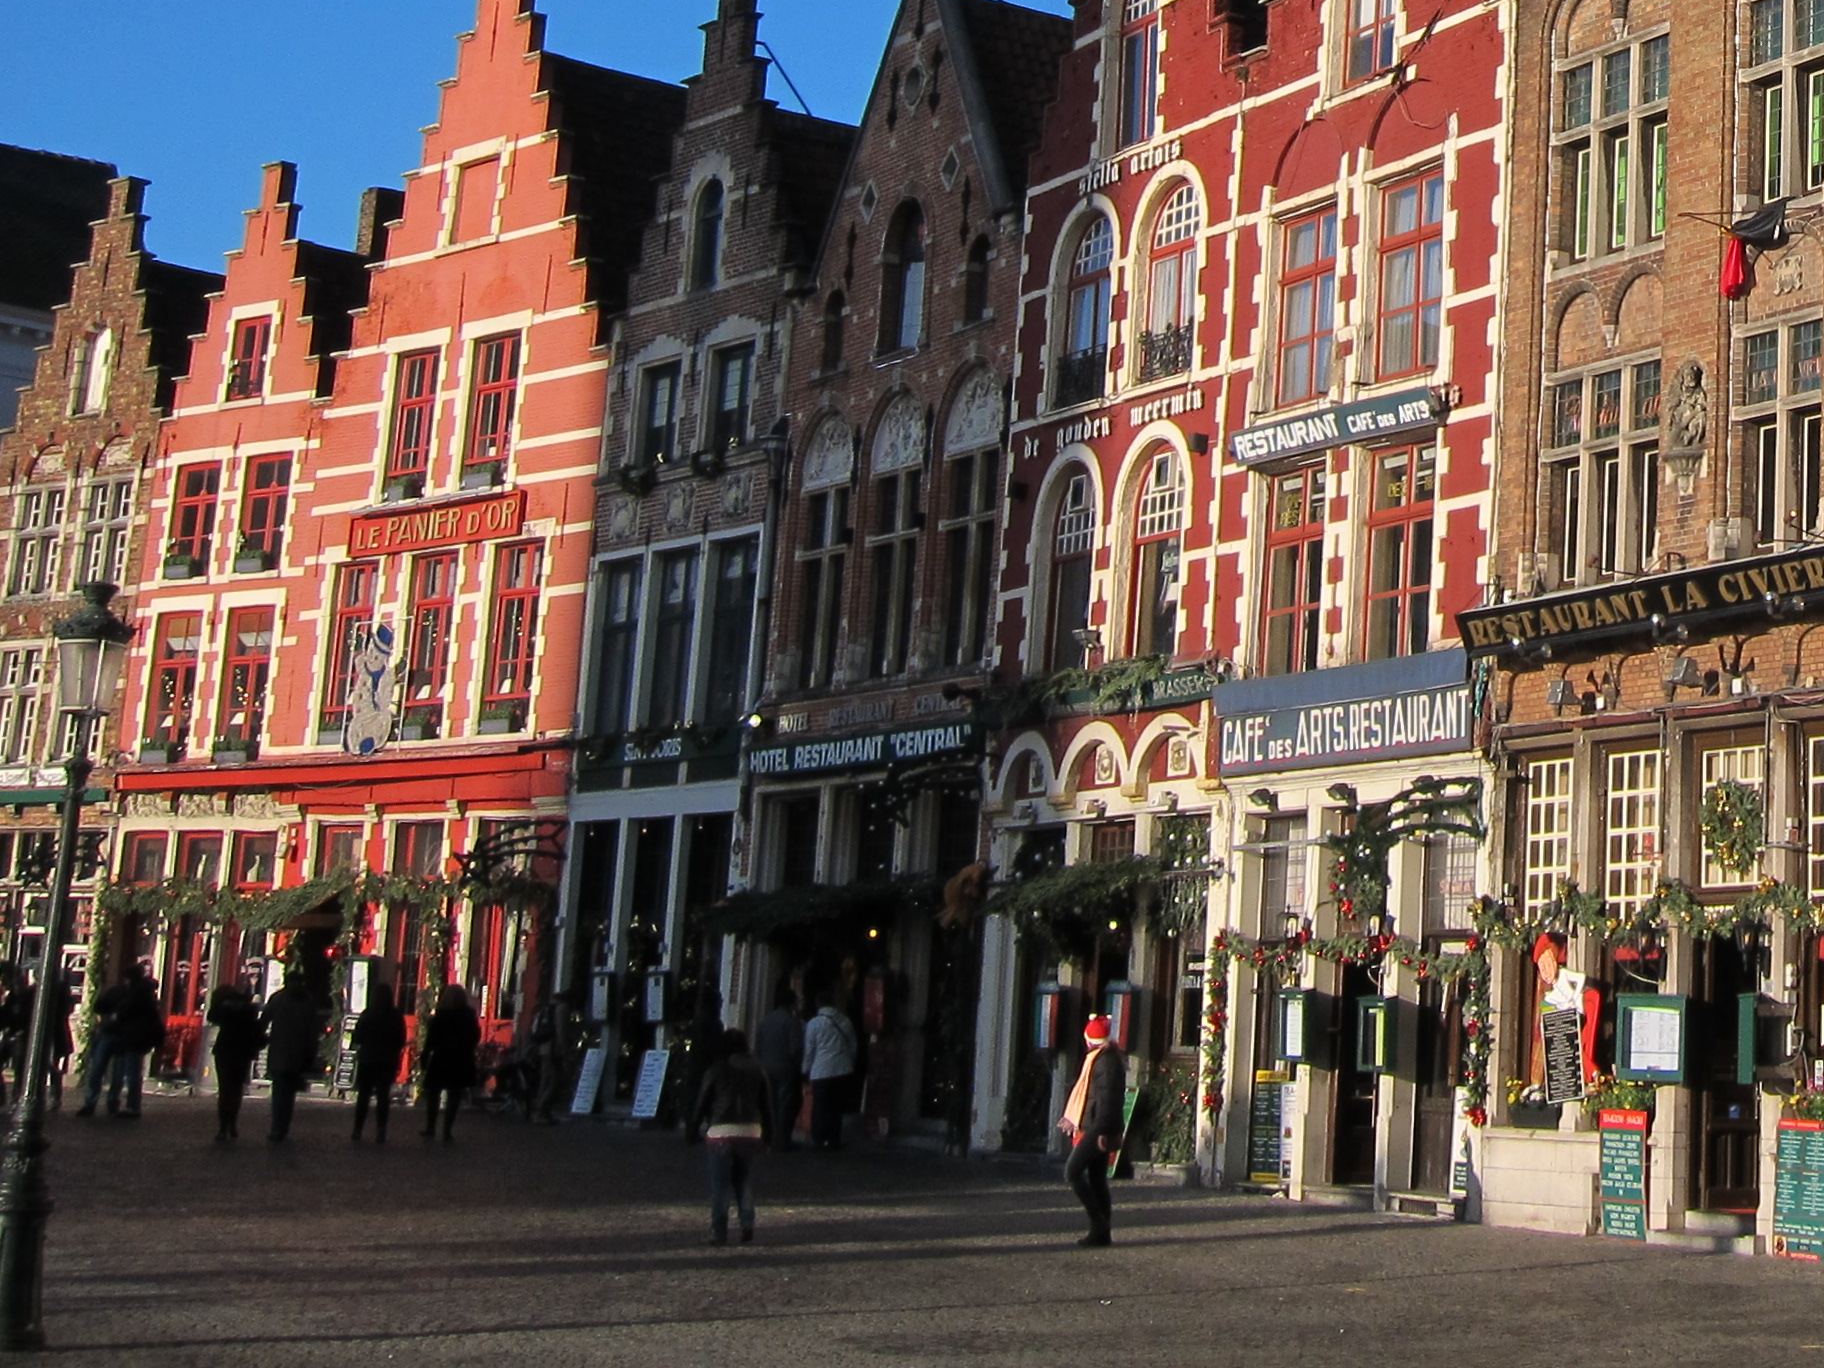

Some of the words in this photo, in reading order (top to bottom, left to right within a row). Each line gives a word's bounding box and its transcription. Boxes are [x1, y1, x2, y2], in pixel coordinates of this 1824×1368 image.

[1130, 139, 1182, 174] artois
[1234, 412, 1339, 460] RESTAURANT
[356, 526, 382, 550] LE
[385, 508, 462, 546] PANIER
[467, 499, 517, 534] D'OR
[1467, 589, 1649, 648] RESTAURANT
[1662, 580, 1707, 614] LA
[777, 712, 809, 733] HOTEL
[1268, 738, 1293, 760] DES
[1347, 689, 1471, 751] RESTAURANT
[750, 748, 789, 773] HOTEL
[794, 735, 884, 769] RESTAURANT
[890, 725, 971, 758] "CENTRAL"
